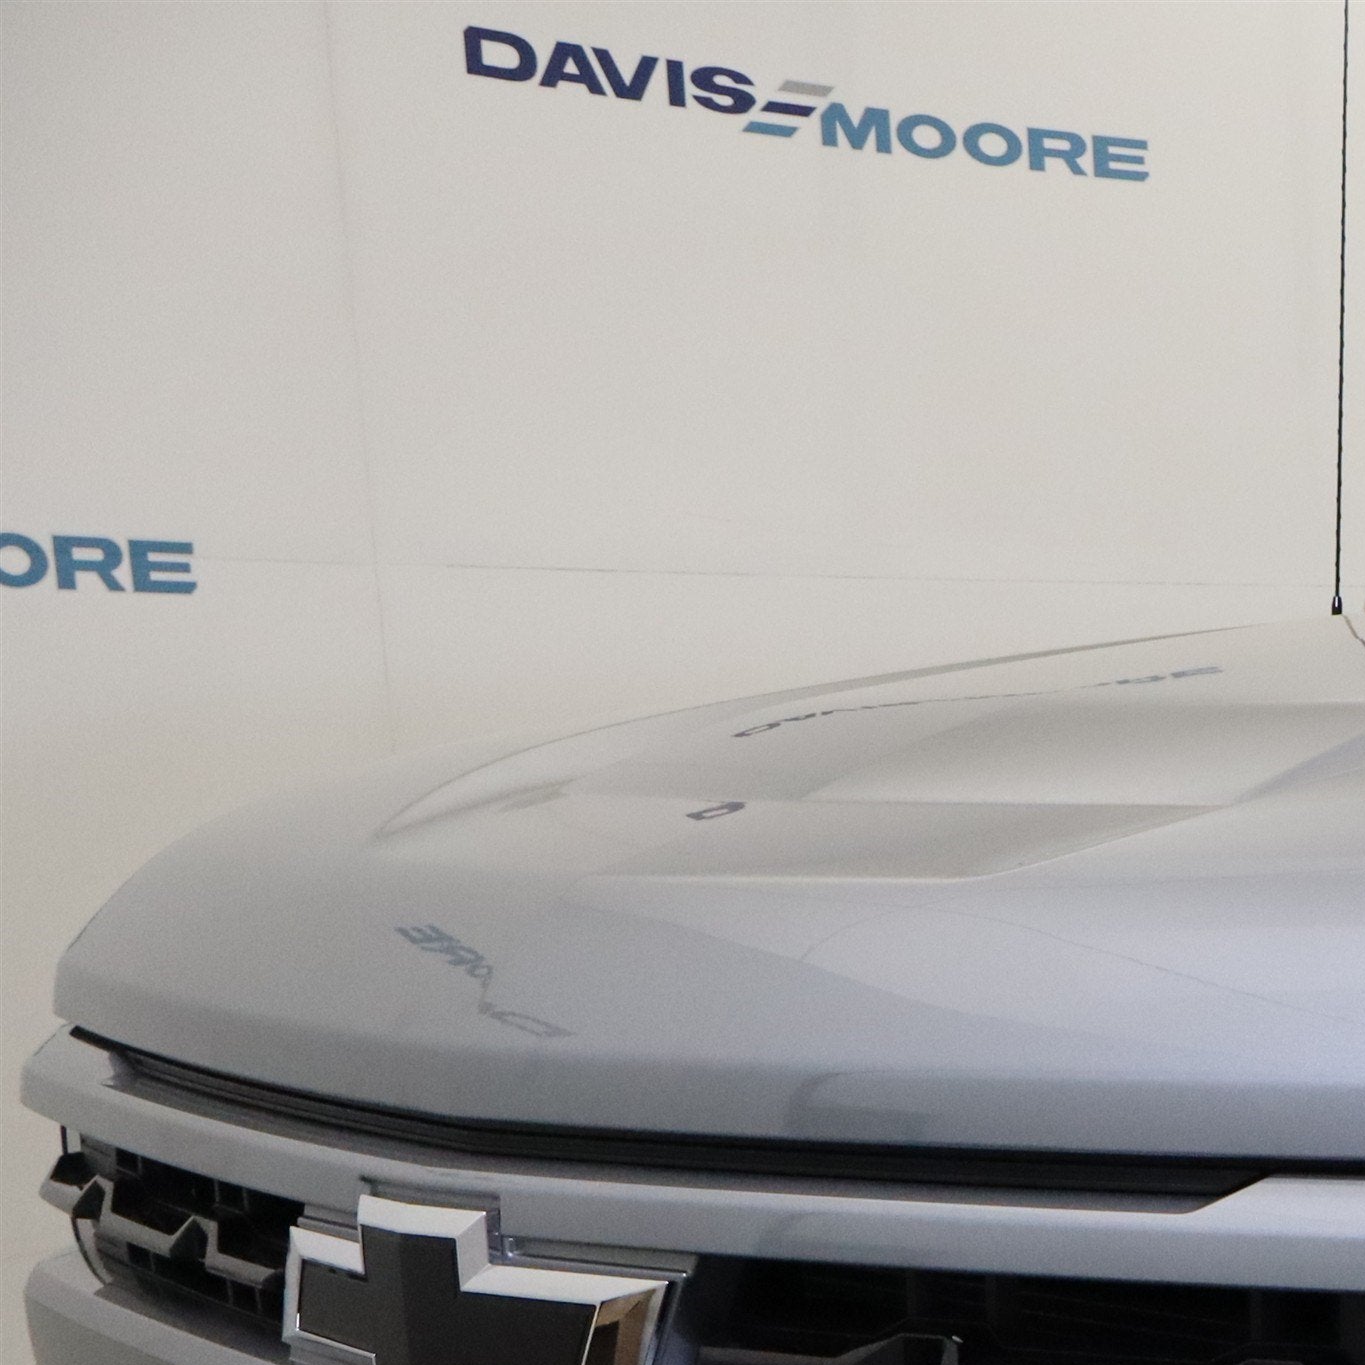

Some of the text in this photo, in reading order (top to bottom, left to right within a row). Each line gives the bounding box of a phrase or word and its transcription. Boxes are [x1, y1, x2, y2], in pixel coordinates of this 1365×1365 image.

[462, 25, 1150, 182] DAVIS MOORE
[0, 532, 197, 594] ORE
